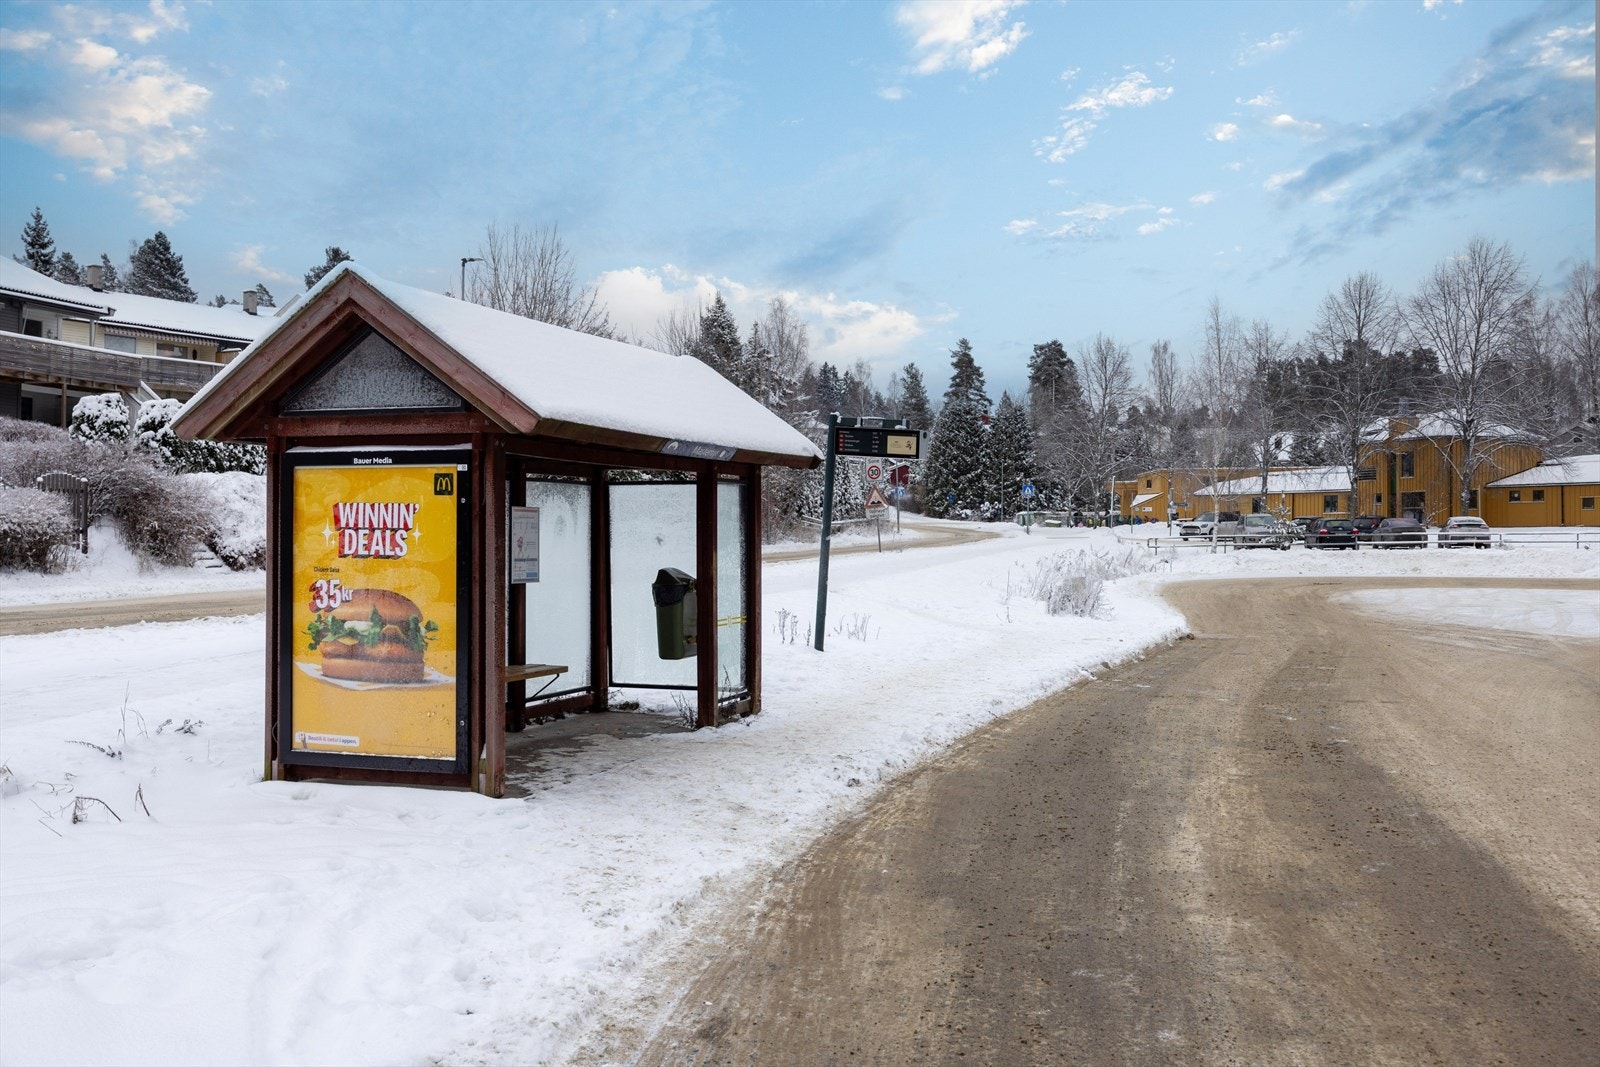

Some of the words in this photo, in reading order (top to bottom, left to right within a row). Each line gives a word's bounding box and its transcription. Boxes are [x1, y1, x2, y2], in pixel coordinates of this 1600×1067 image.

[373, 456, 392, 464] Media
[335, 502, 420, 529] WINNIN'
[341, 529, 408, 557] DEALS
